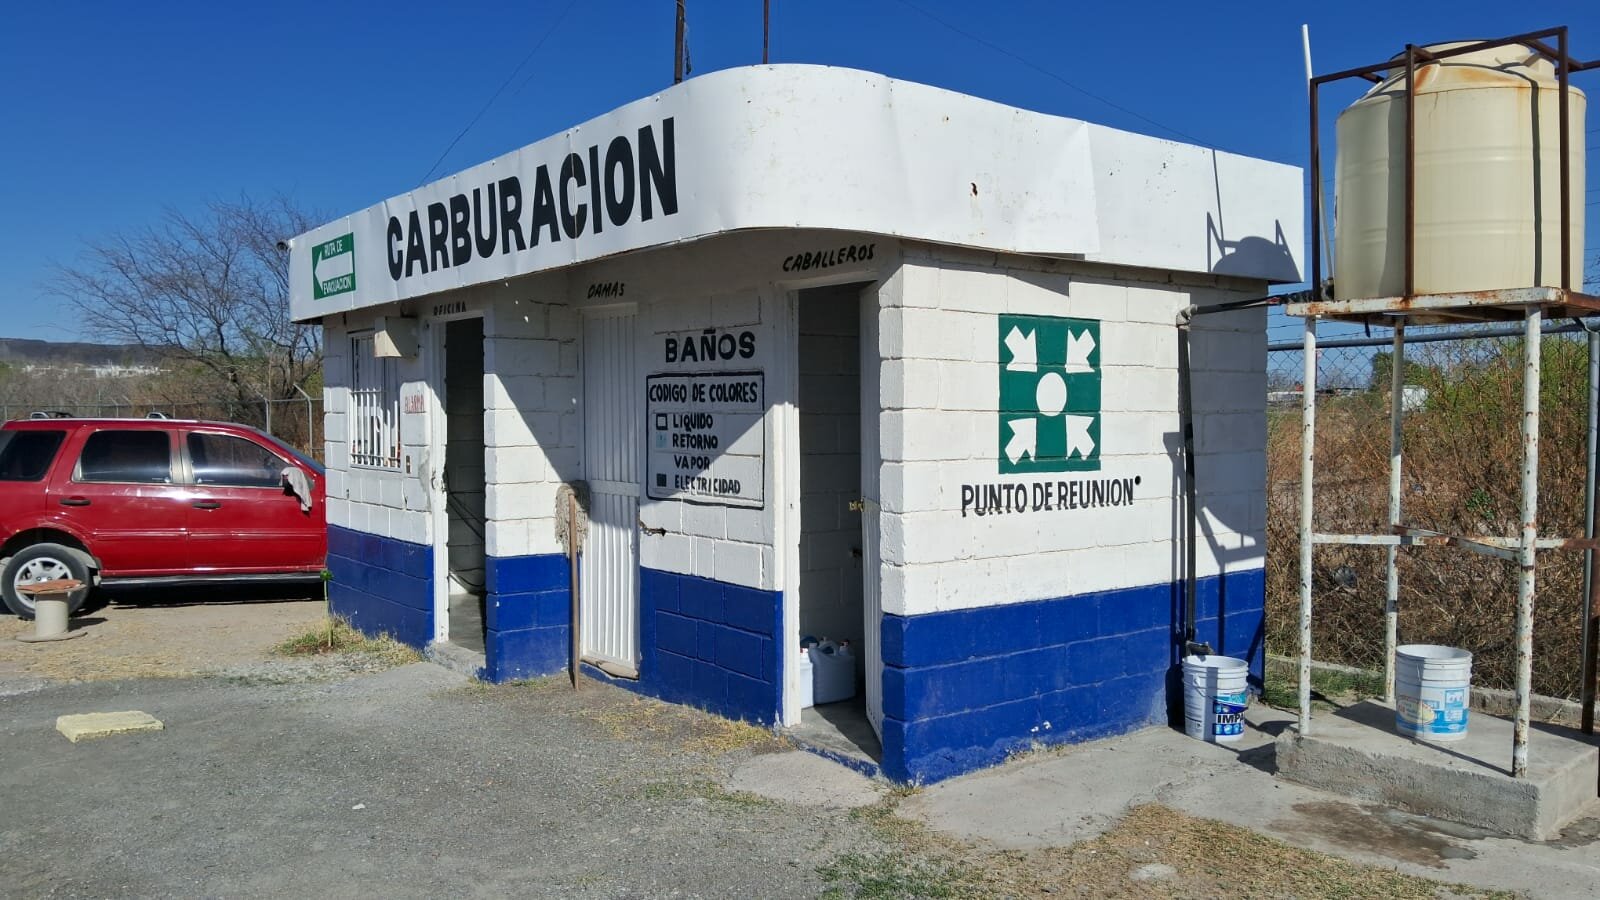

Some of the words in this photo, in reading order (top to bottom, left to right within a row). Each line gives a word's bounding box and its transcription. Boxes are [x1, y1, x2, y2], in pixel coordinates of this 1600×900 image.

[387, 116, 678, 281] CARBURACION
[336, 240, 343, 253] DE
[782, 243, 876, 272] CABALLEROS
[587, 281, 625, 299] DAMAS
[433, 301, 467, 316] OFICINA
[665, 328, 756, 363] BAÑOS
[649, 383, 687, 403] CODIGO
[692, 383, 706, 402] DE
[709, 381, 758, 403] COLORES
[672, 413, 714, 432] LIQUIDO
[672, 433, 719, 450] RETORNO
[673, 454, 711, 471] VAPOR
[674, 474, 741, 495] ELECTRICIDAD
[961, 483, 1028, 517] PUNTO
[1032, 482, 1053, 512] DE
